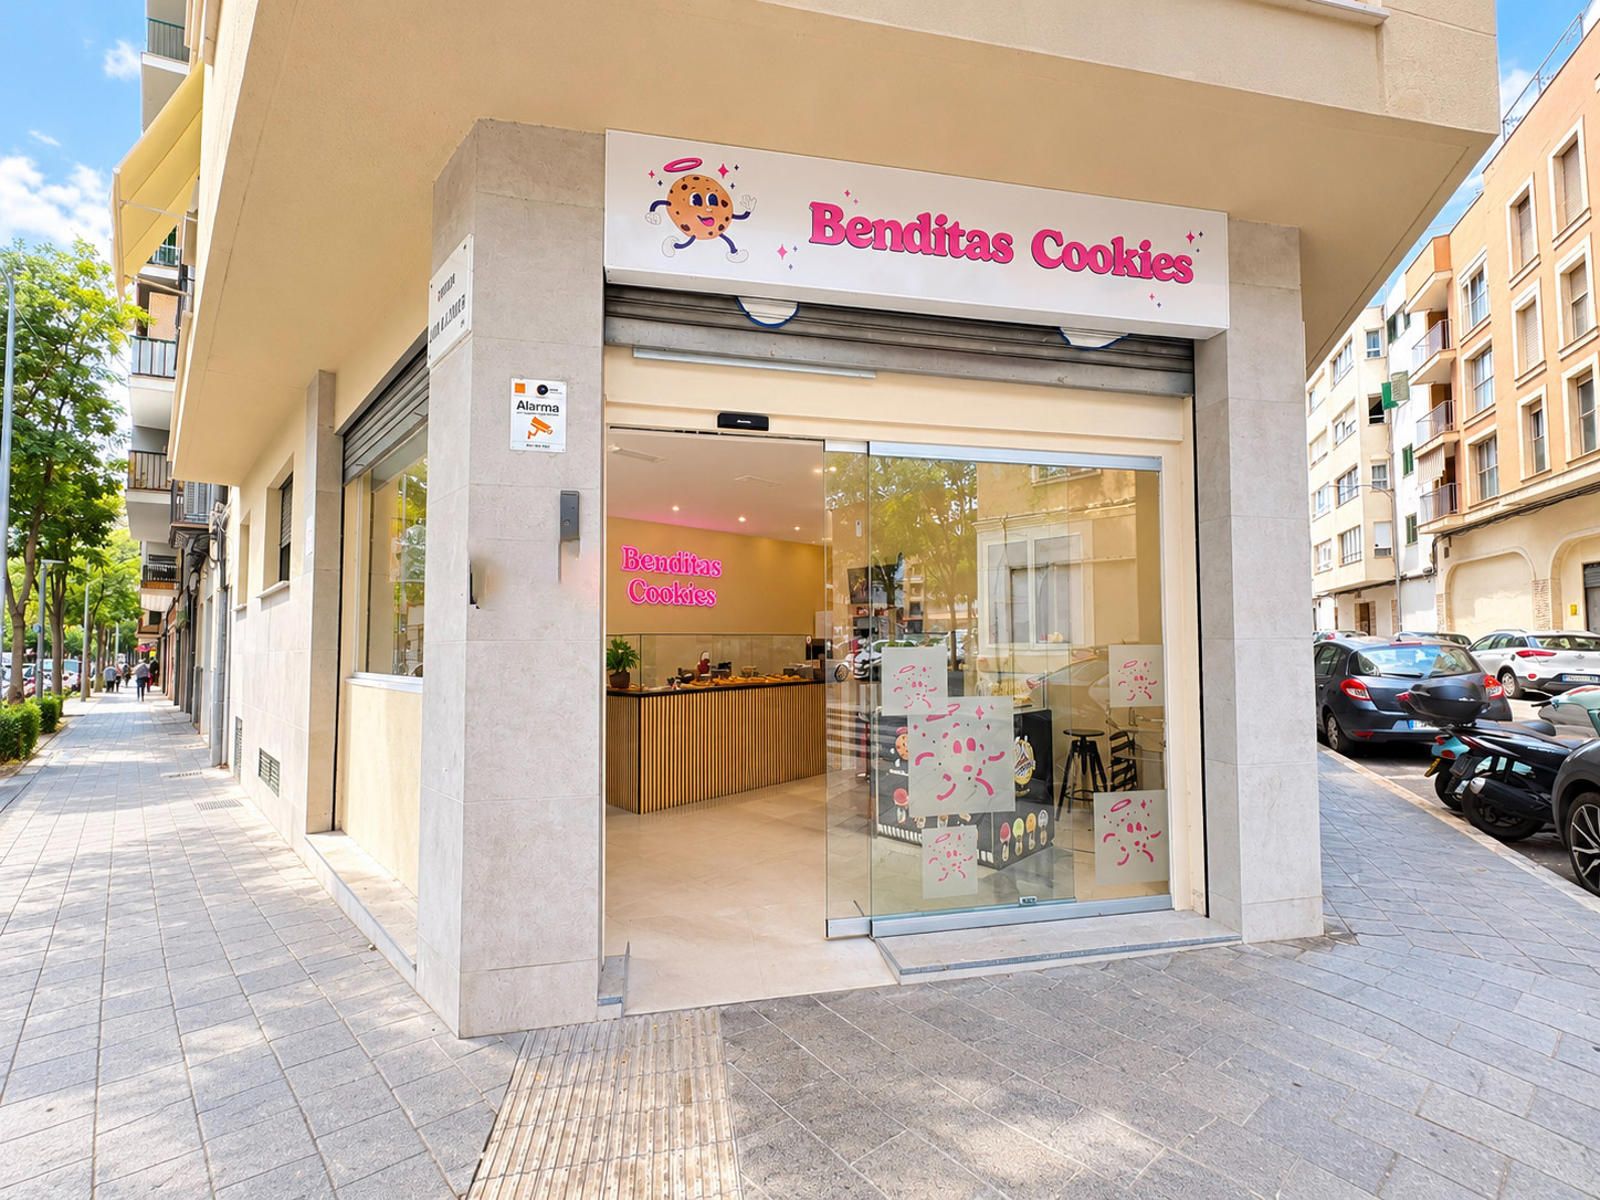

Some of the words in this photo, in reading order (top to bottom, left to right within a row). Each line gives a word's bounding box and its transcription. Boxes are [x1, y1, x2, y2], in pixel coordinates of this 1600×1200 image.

[809, 201, 1014, 264] Benditas
[1031, 229, 1194, 284] Cookies
[516, 400, 560, 413] Alarma
[621, 545, 722, 577] Benditas
[627, 578, 717, 608] Cookies
